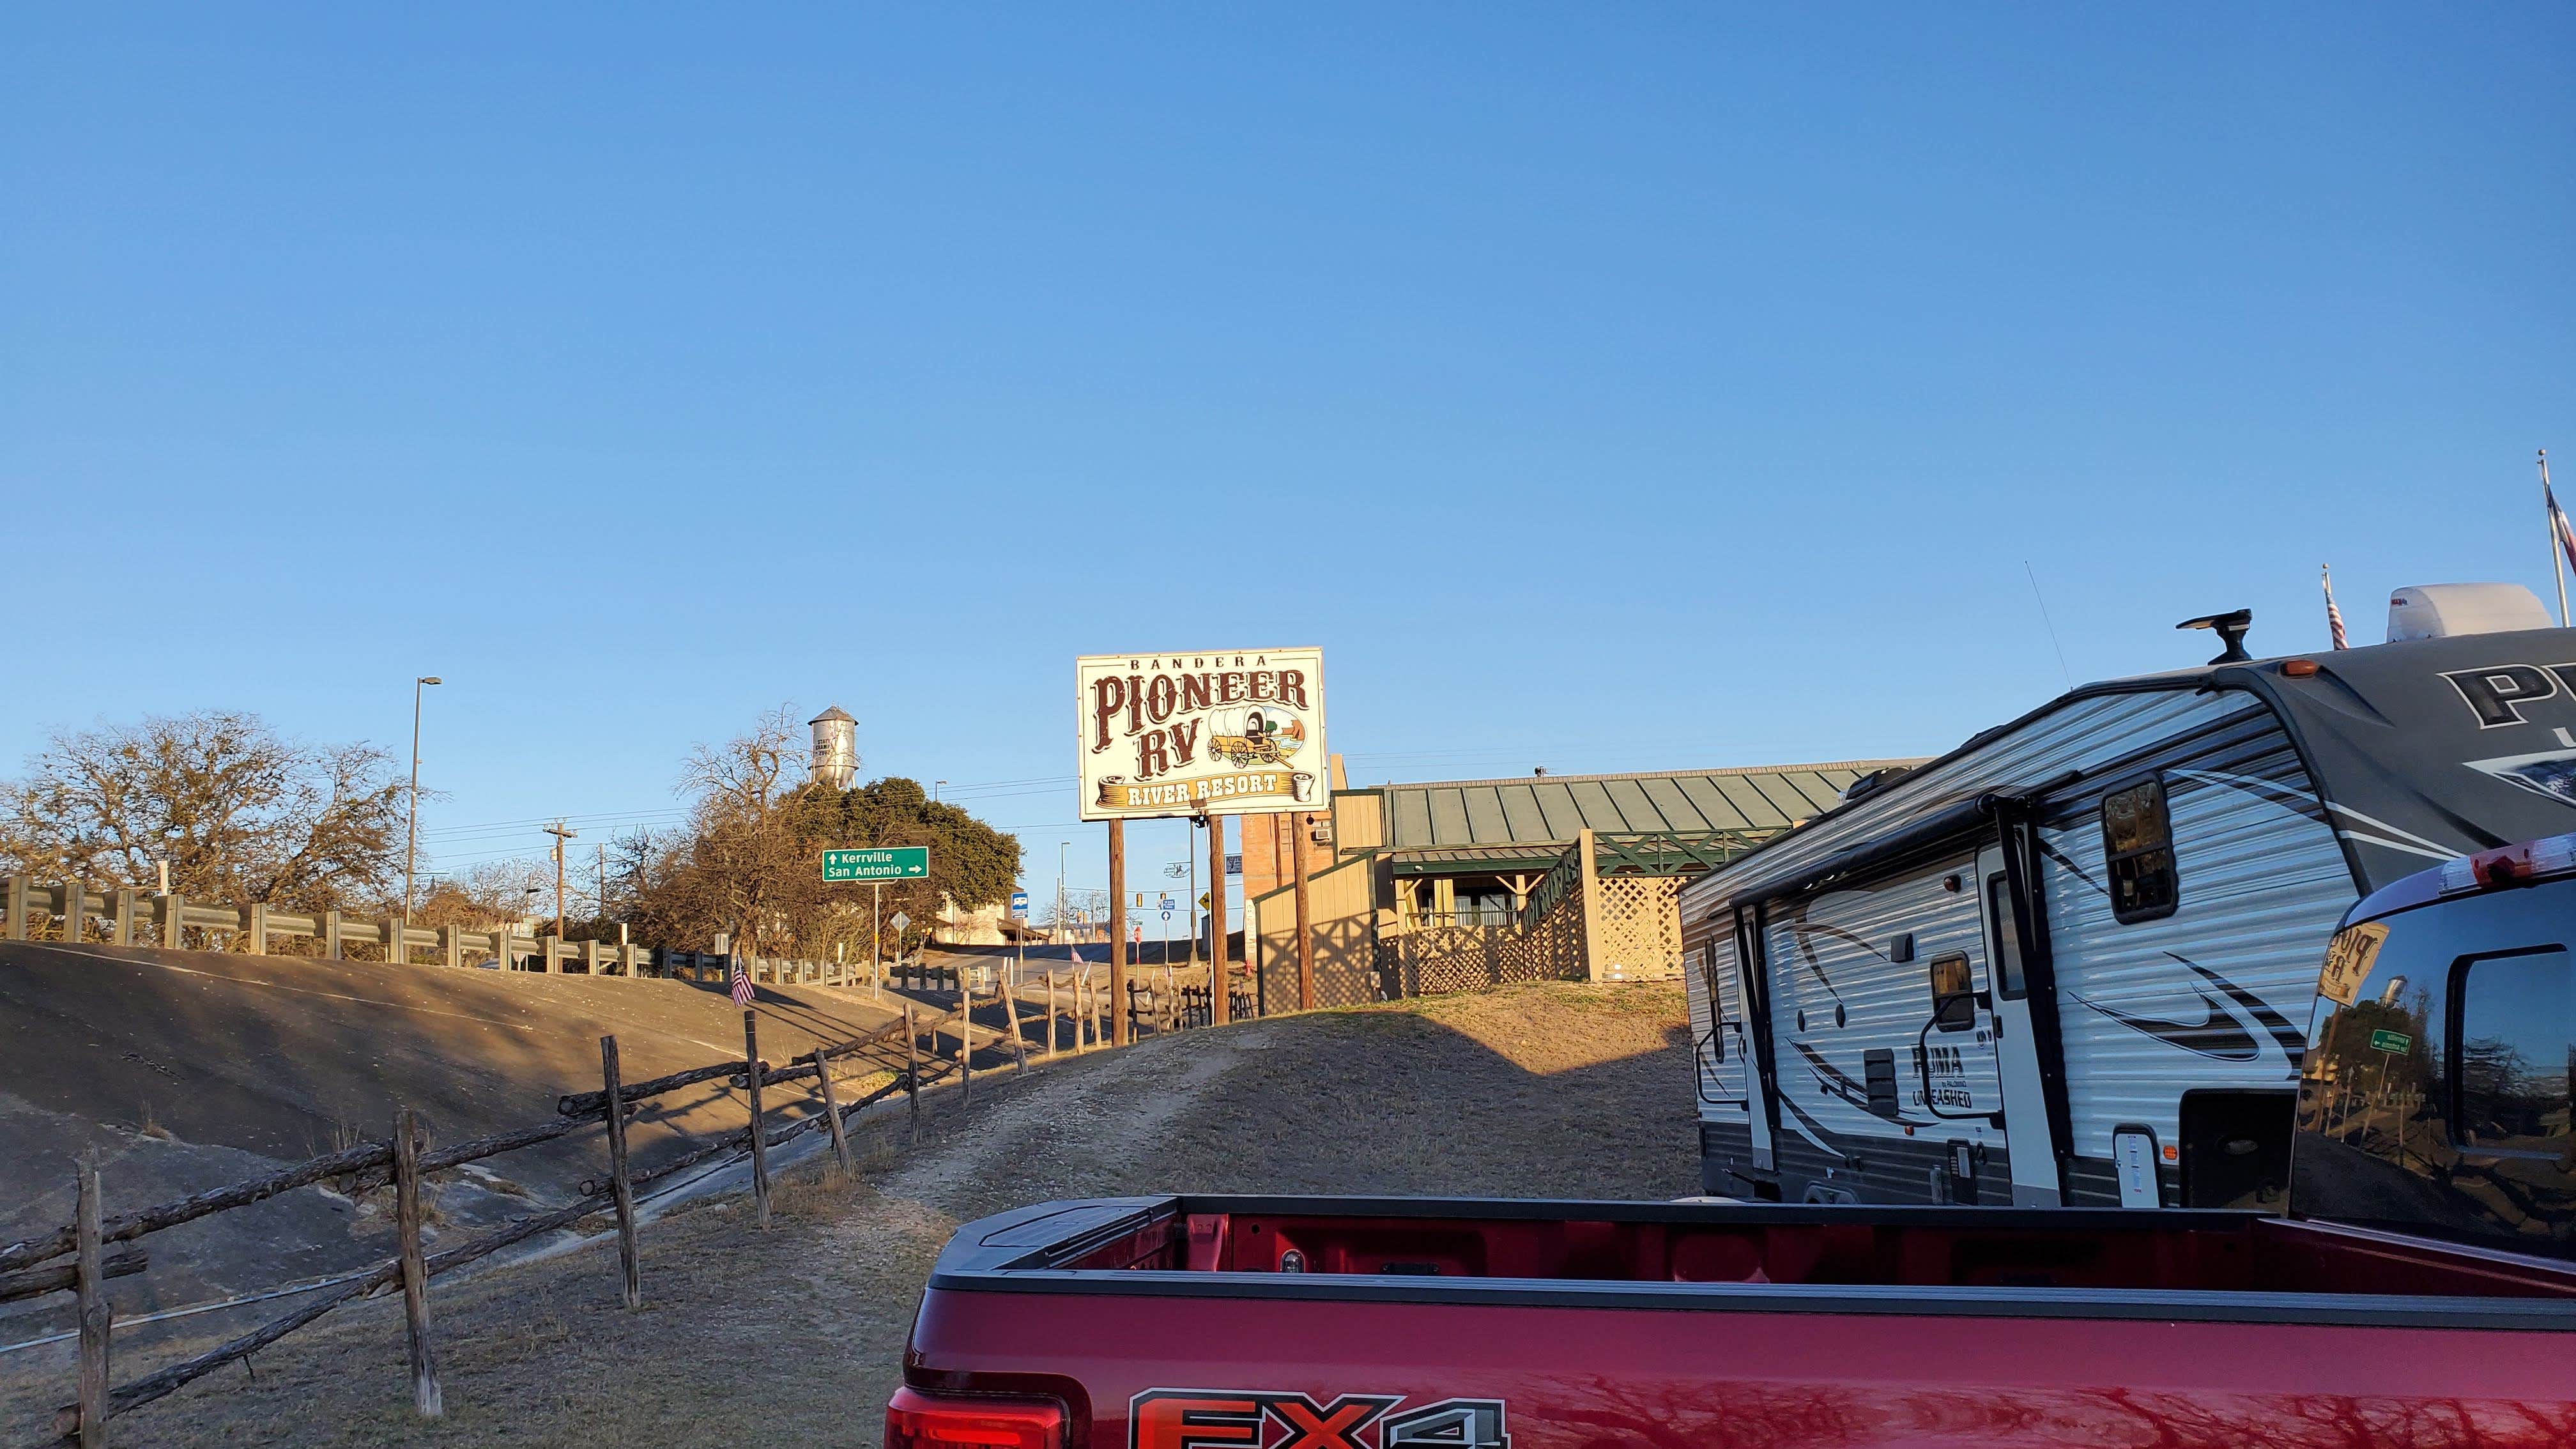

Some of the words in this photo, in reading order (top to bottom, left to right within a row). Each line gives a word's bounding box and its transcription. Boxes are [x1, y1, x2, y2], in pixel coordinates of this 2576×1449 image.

[1130, 655, 1267, 670] BANDERA
[1090, 670, 1310, 754] PIONEER
[1133, 717, 1204, 781] RV
[1127, 783, 1191, 806] RIVER
[1196, 774, 1277, 801] RESORT
[828, 867, 850, 877] San
[855, 864, 902, 877] Antonio
[841, 852, 893, 864] Kerrville
[1913, 1089, 1972, 1109] UNEASHED
[1128, 1387, 1512, 1449] FX4
